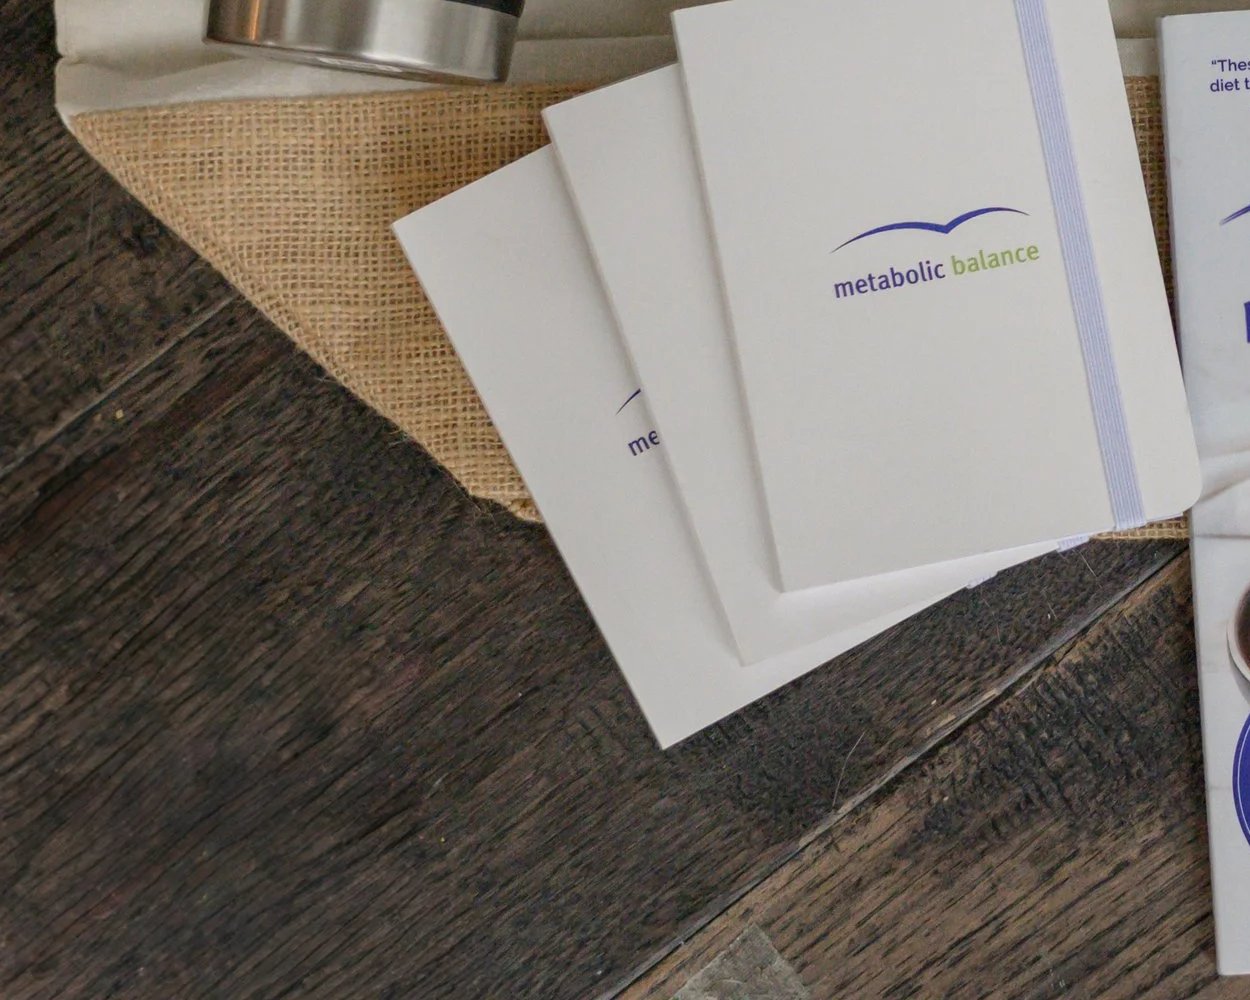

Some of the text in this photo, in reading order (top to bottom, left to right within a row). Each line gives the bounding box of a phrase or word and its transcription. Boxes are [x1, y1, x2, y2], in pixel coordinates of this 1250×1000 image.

[1209, 77, 1241, 93] diet
[833, 245, 1039, 299] metabolic balance
